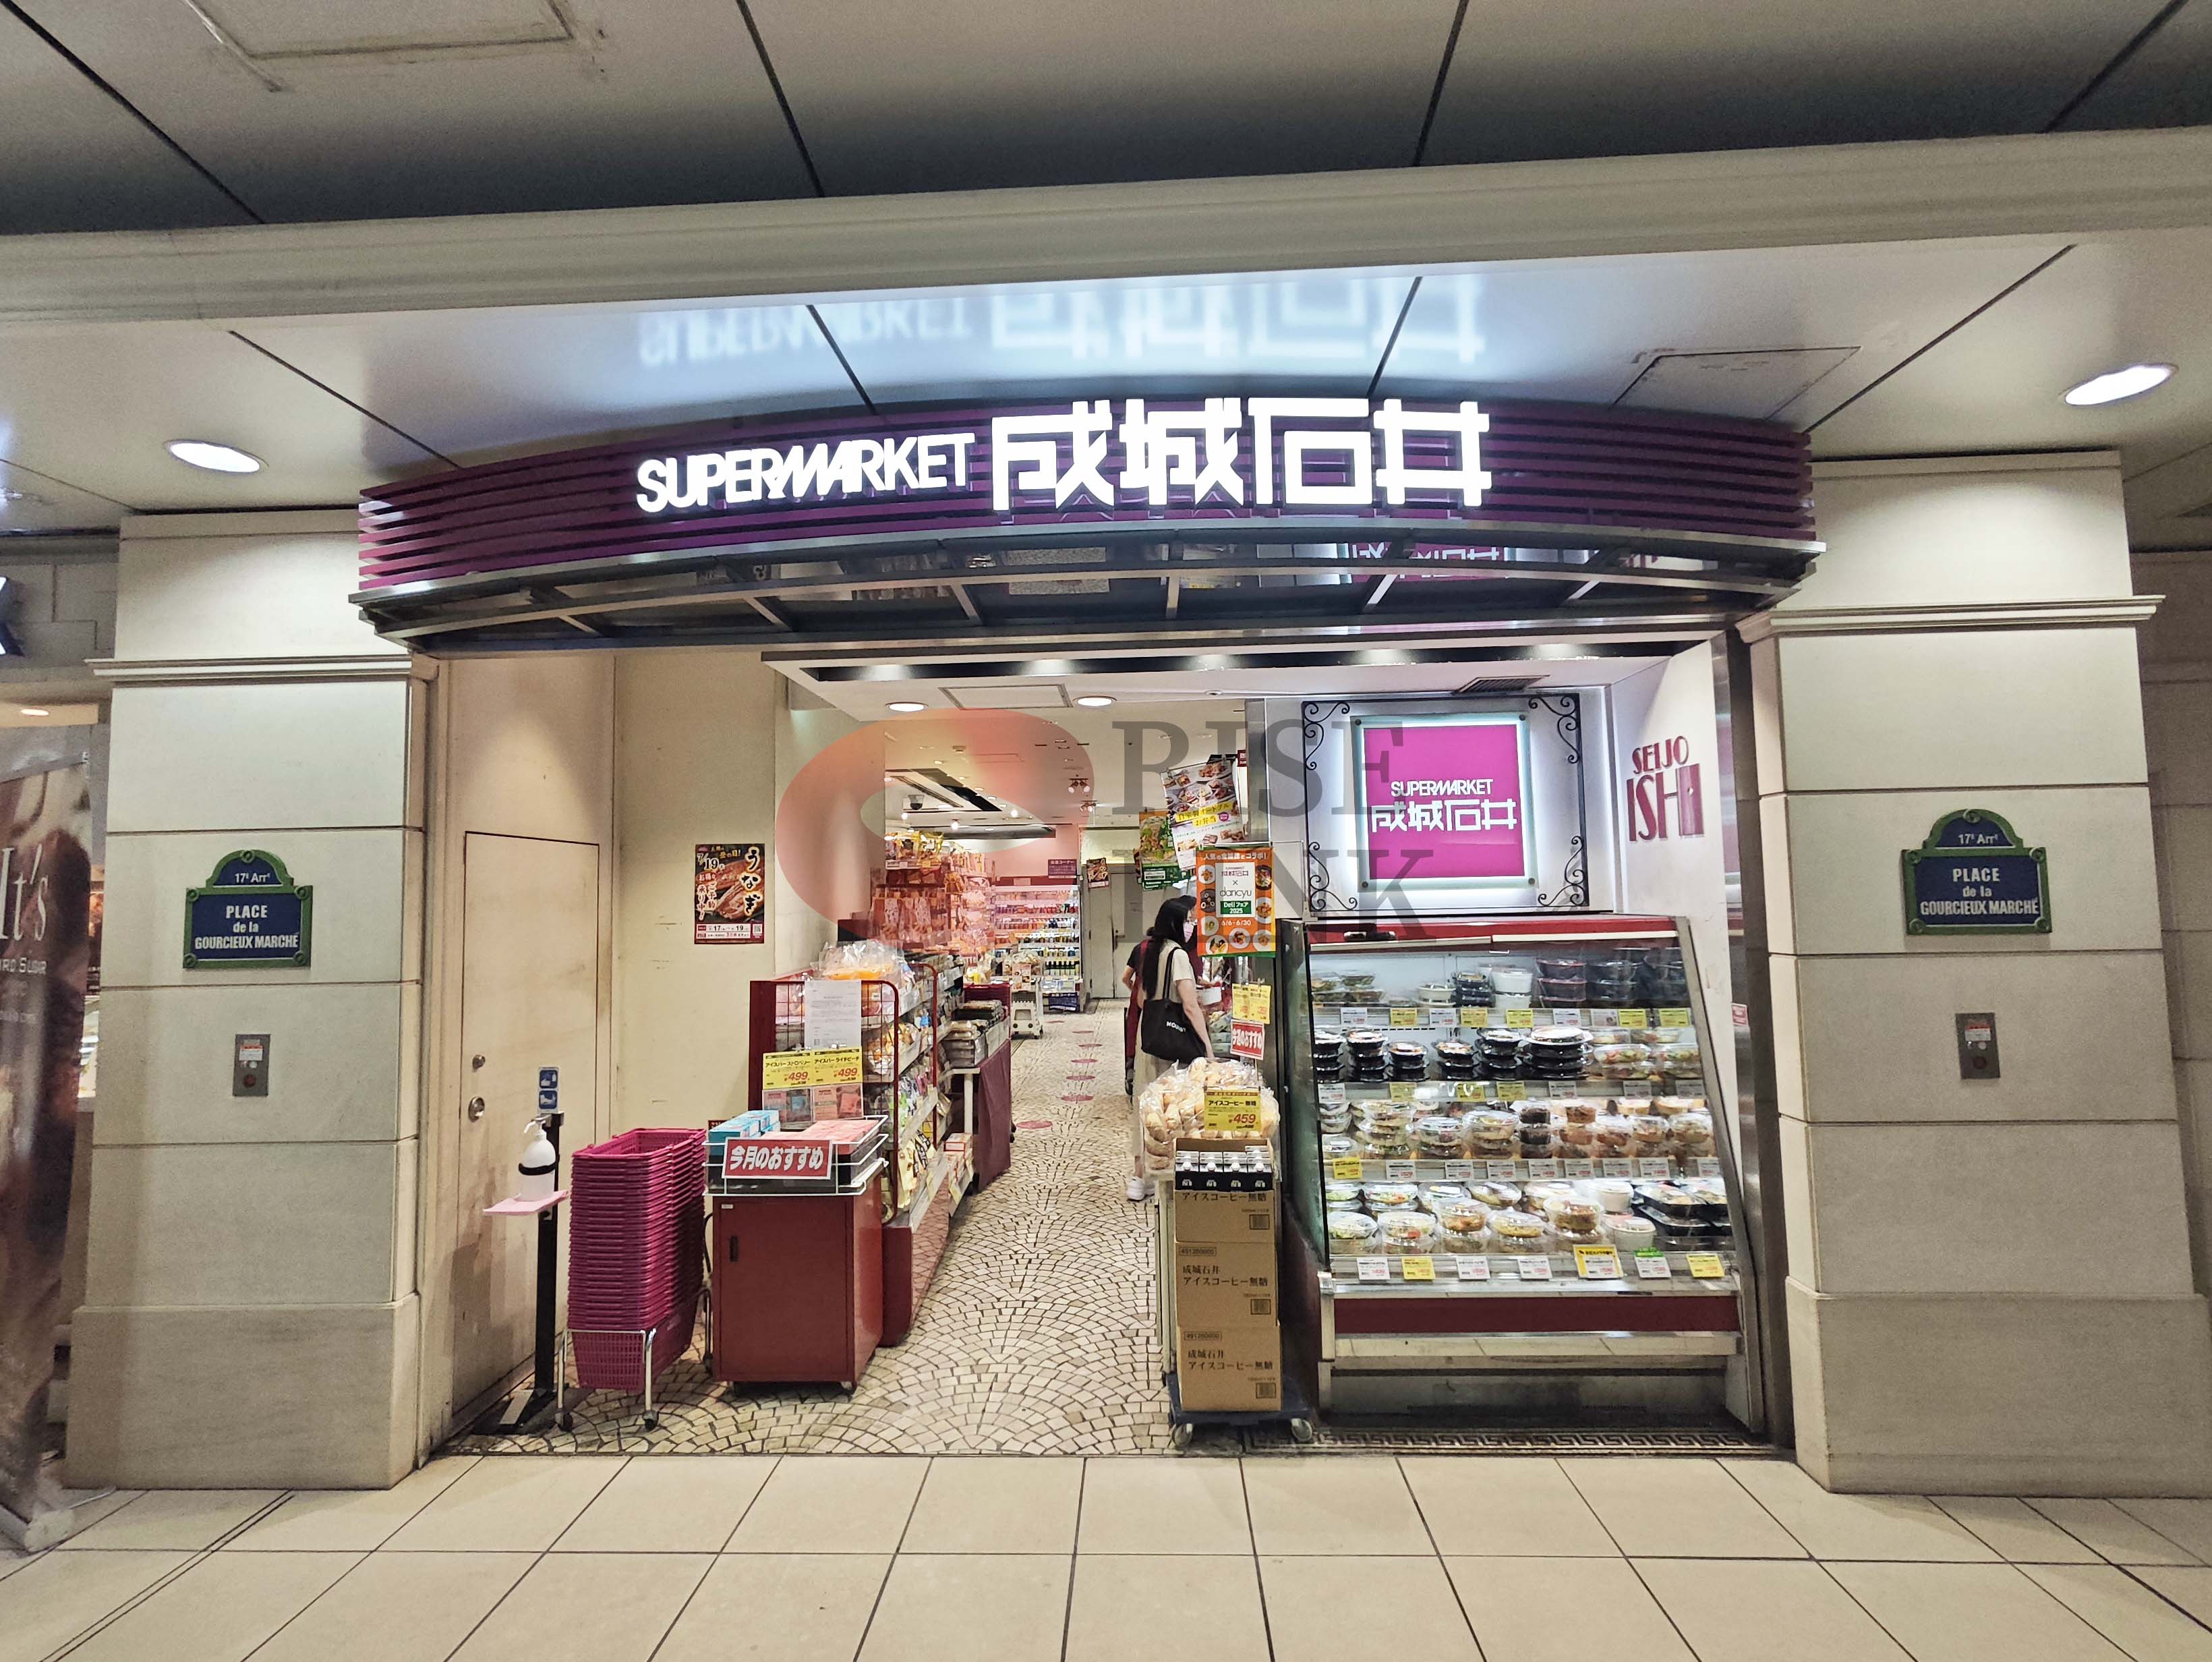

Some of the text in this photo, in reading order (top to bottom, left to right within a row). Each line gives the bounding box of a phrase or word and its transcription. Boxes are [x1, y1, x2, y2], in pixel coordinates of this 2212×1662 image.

[992, 397, 1491, 511] 成城石井
[637, 432, 974, 513] SUPERMARKET
[1632, 736, 1689, 774] SEIJO
[1391, 779, 1493, 797] SUPERMARKET
[1372, 799, 1517, 832] 成城石井
[740, 847, 763, 915] うなぎ
[1952, 868, 2000, 882] PLACE
[1219, 886, 1252, 898] dancyu
[1962, 886, 1992, 897] de la
[226, 905, 268, 918] PLACE
[1920, 897, 2039, 915] GOURCIEUX MARCHÉ
[233, 921, 259, 933] de la
[195, 932, 299, 950] GOURCIEUX MARCHÉ
[730, 1145, 824, 1171] 今月のおすすめ
[1183, 1265, 1220, 1274] 成城石井
